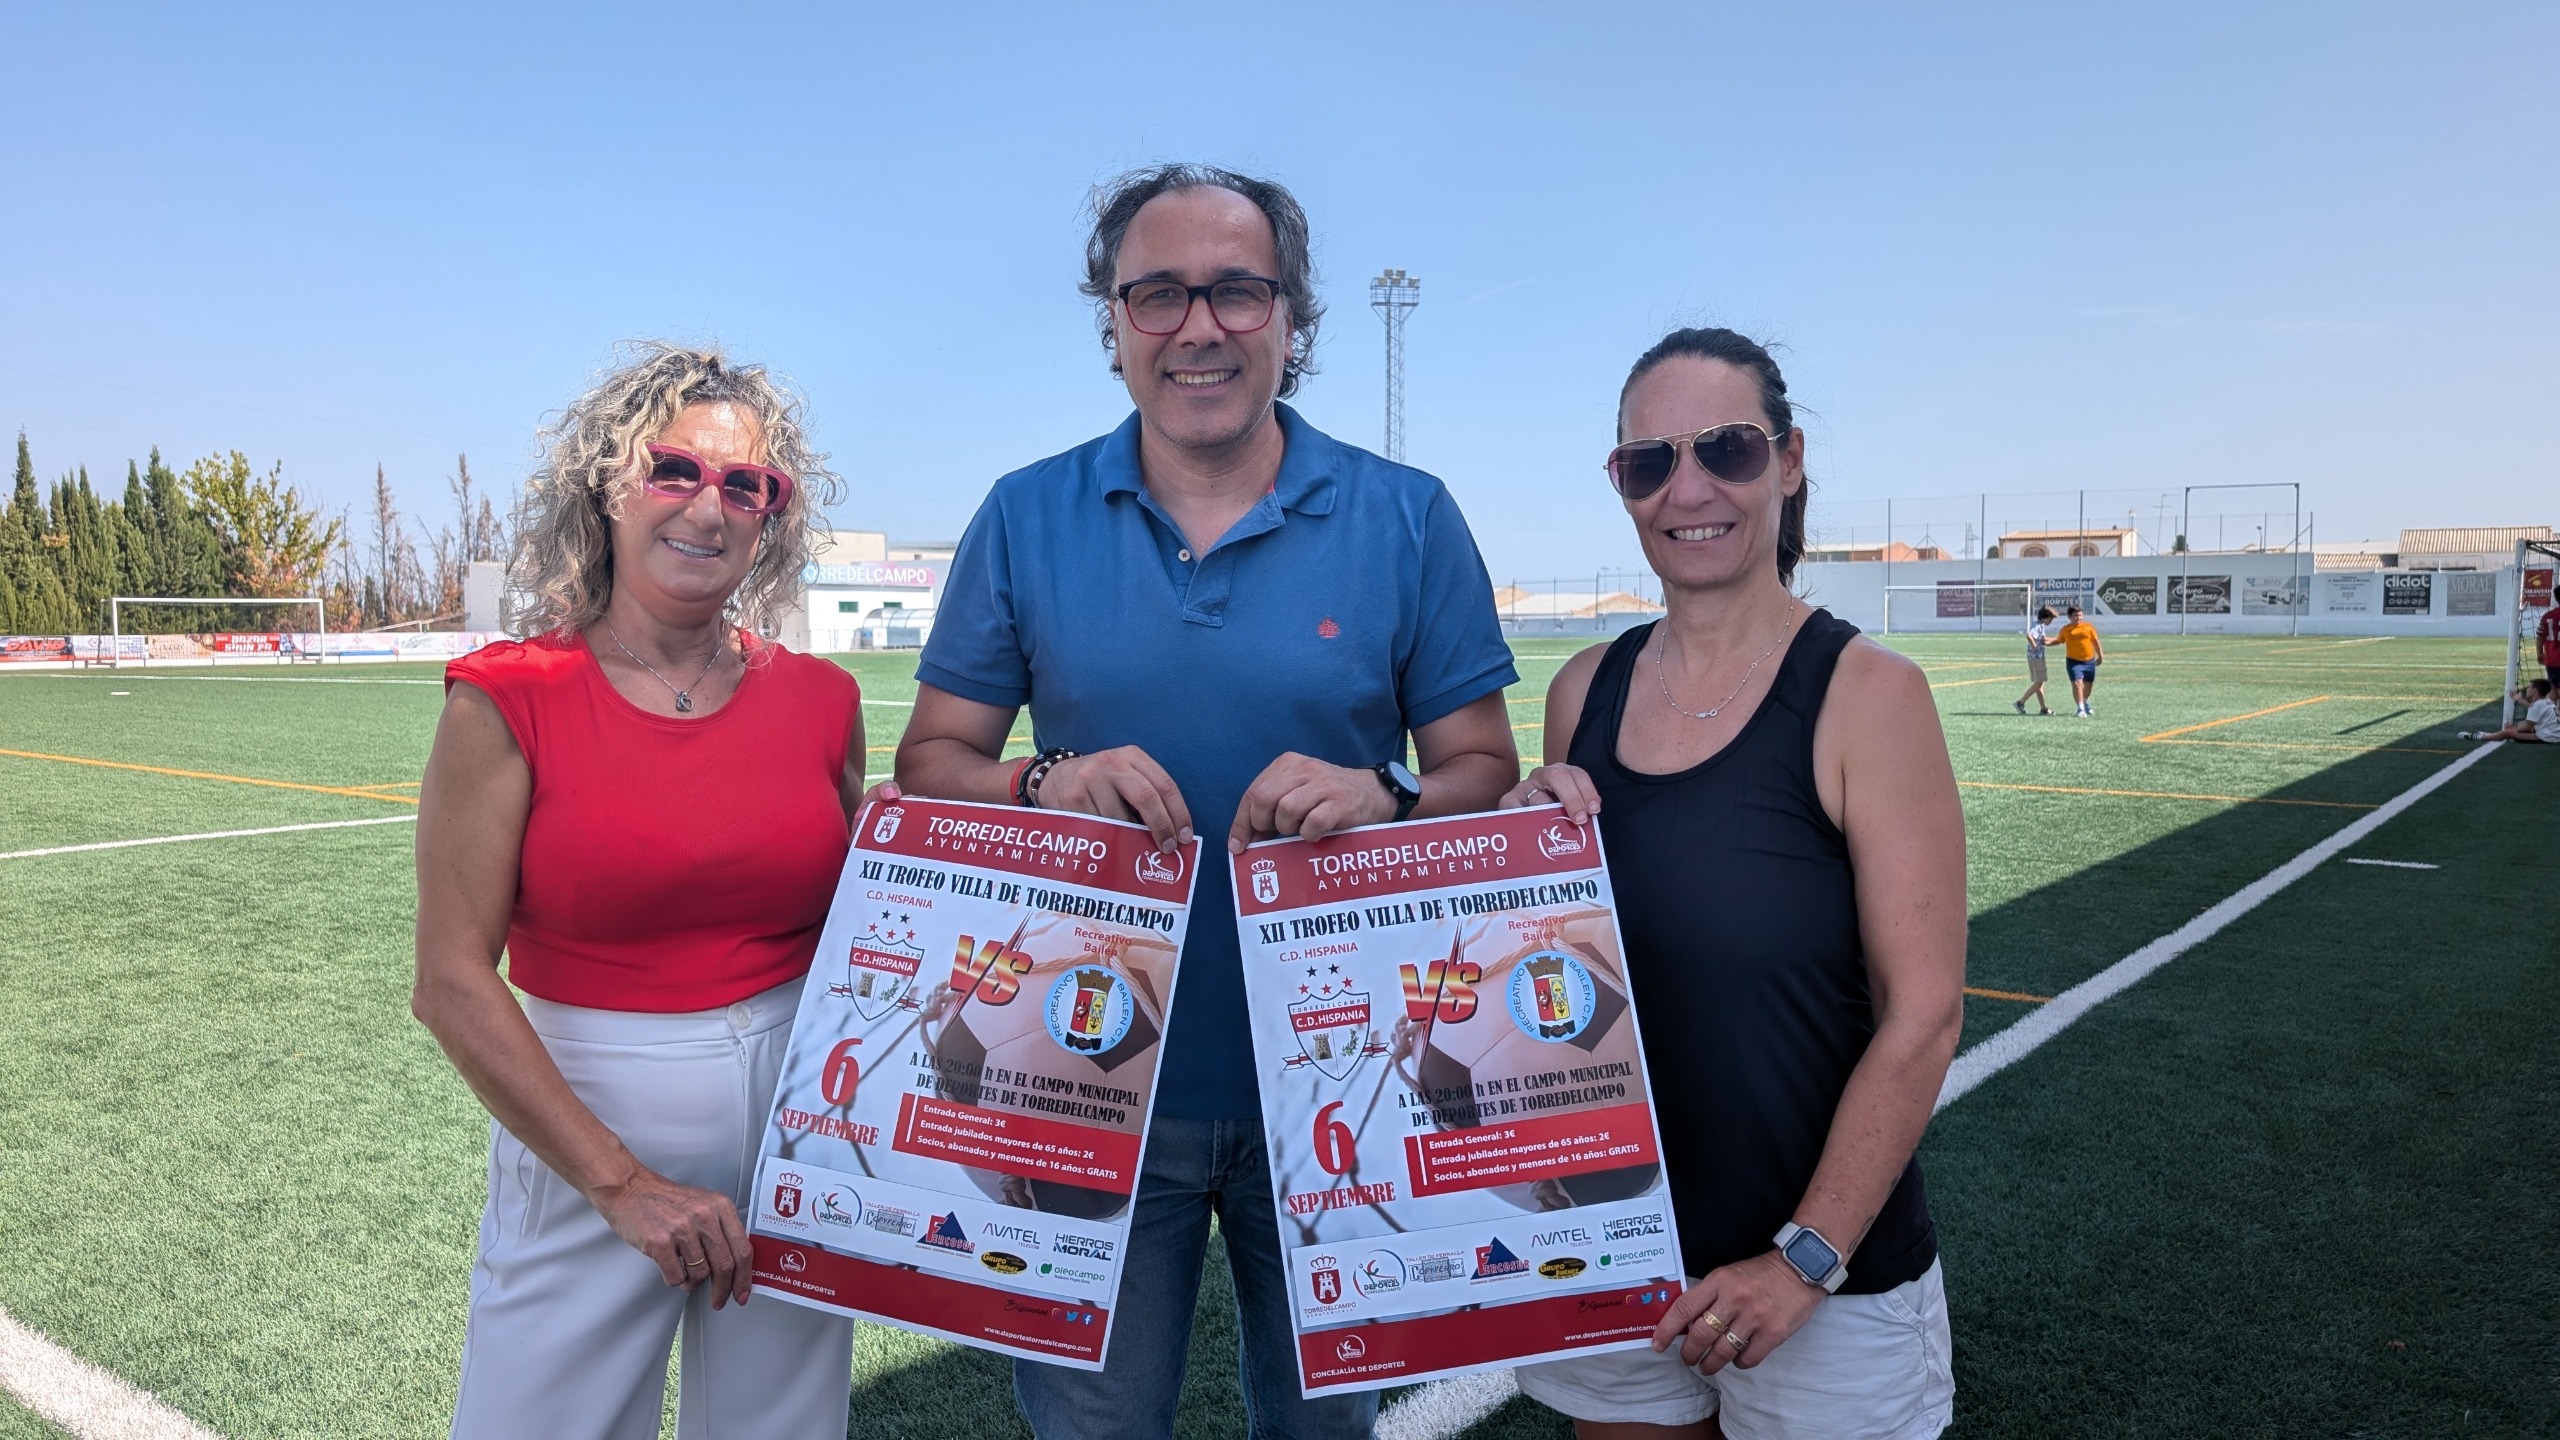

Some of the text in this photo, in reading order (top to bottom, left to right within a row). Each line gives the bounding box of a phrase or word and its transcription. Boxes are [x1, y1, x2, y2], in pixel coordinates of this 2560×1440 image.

[802, 566, 928, 584] ORREDELCAMPO
[2385, 575, 2429, 588] didot
[2546, 618, 2560, 641] 1
[927, 816, 1107, 860] TORREDELCAMPO
[925, 837, 1098, 874] AYUNTAMIENTO
[1308, 833, 1508, 876] TORREDELCAMPO
[1317, 855, 1506, 891] AYUNTAMIENTO
[859, 859, 1175, 932] XII TROFEO VILLA DE TORREDELCAMPO
[866, 890, 933, 909] C.D. HISPANIA
[1258, 879, 1599, 945] XII TROFEO VILLA DE TORREDELCAMPO
[1508, 915, 1566, 931] Recreativo
[1074, 927, 1132, 946] Recreativo
[855, 941, 921, 959] TORREDELCAMPO
[1279, 942, 1359, 963] C.D. HISPANIA
[948, 933, 1034, 1007] VS
[1399, 959, 1482, 1024] VS
[1512, 967, 1536, 1033] RECREATIVO
[1050, 974, 1074, 1038] RECREATIVO
[1292, 997, 1367, 1013] TORREDELCAMPO
[821, 1037, 863, 1105] 6
[909, 1052, 1140, 1107] A LAS 20:00 h EN EL CAMPO MUNICIPAL
[1398, 1062, 1633, 1109] A LAS 20:00 h EN EL CAMPO MUNICIPAL
[916, 1073, 1126, 1125] DE DEPORTES DE TORREDELCAMPO
[1412, 1083, 1626, 1128] DE DEPORTES DE TORREDELCAMPO
[780, 1107, 880, 1147] SEPTIEMBRE
[923, 1104, 1006, 1128] Entrada General: 3€
[920, 1119, 1095, 1160] Entrada jubilados mayores de 65 años: 2€
[1313, 1100, 1356, 1175] 6
[1429, 1129, 1516, 1150] Entrada General: 3€
[1431, 1131, 1610, 1166] Entrada jubilados mayores de 65 años: 2€
[916, 1135, 1118, 1180] Socios, abonados y menores de 16 años: GRATIS
[1434, 1143, 1640, 1183] Socios, abonados y menores de 16 años: GRATIS
[1287, 1181, 1396, 1216] SEPTIEMBRE
[761, 1213, 809, 1229] TORREDELCAMPO
[1602, 1213, 1663, 1230] HIERROS
[982, 1222, 1041, 1245] AVATEL
[1055, 1232, 1115, 1251] HIERROS
[1531, 1227, 1592, 1248] AVATEL
[1604, 1224, 1665, 1242] MORAL
[1018, 1242, 1040, 1250] TELECOM
[1053, 1243, 1112, 1262] MORAL
[1614, 1247, 1665, 1262] oleocampo
[982, 1253, 1007, 1264] GRUPO
[1539, 1263, 1565, 1273] GRUPO
[1054, 1266, 1106, 1282] oleocampo
[792, 1279, 801, 1287] DE
[802, 1282, 836, 1296] DEPORTES
[1304, 1302, 1357, 1314] TORREDELCAMPO
[1564, 1325, 1657, 1341] www.deportestorredelcamp
[1311, 1366, 1356, 1379] CONCEJALÍA
[1368, 1360, 1406, 1372] DEPORTES
